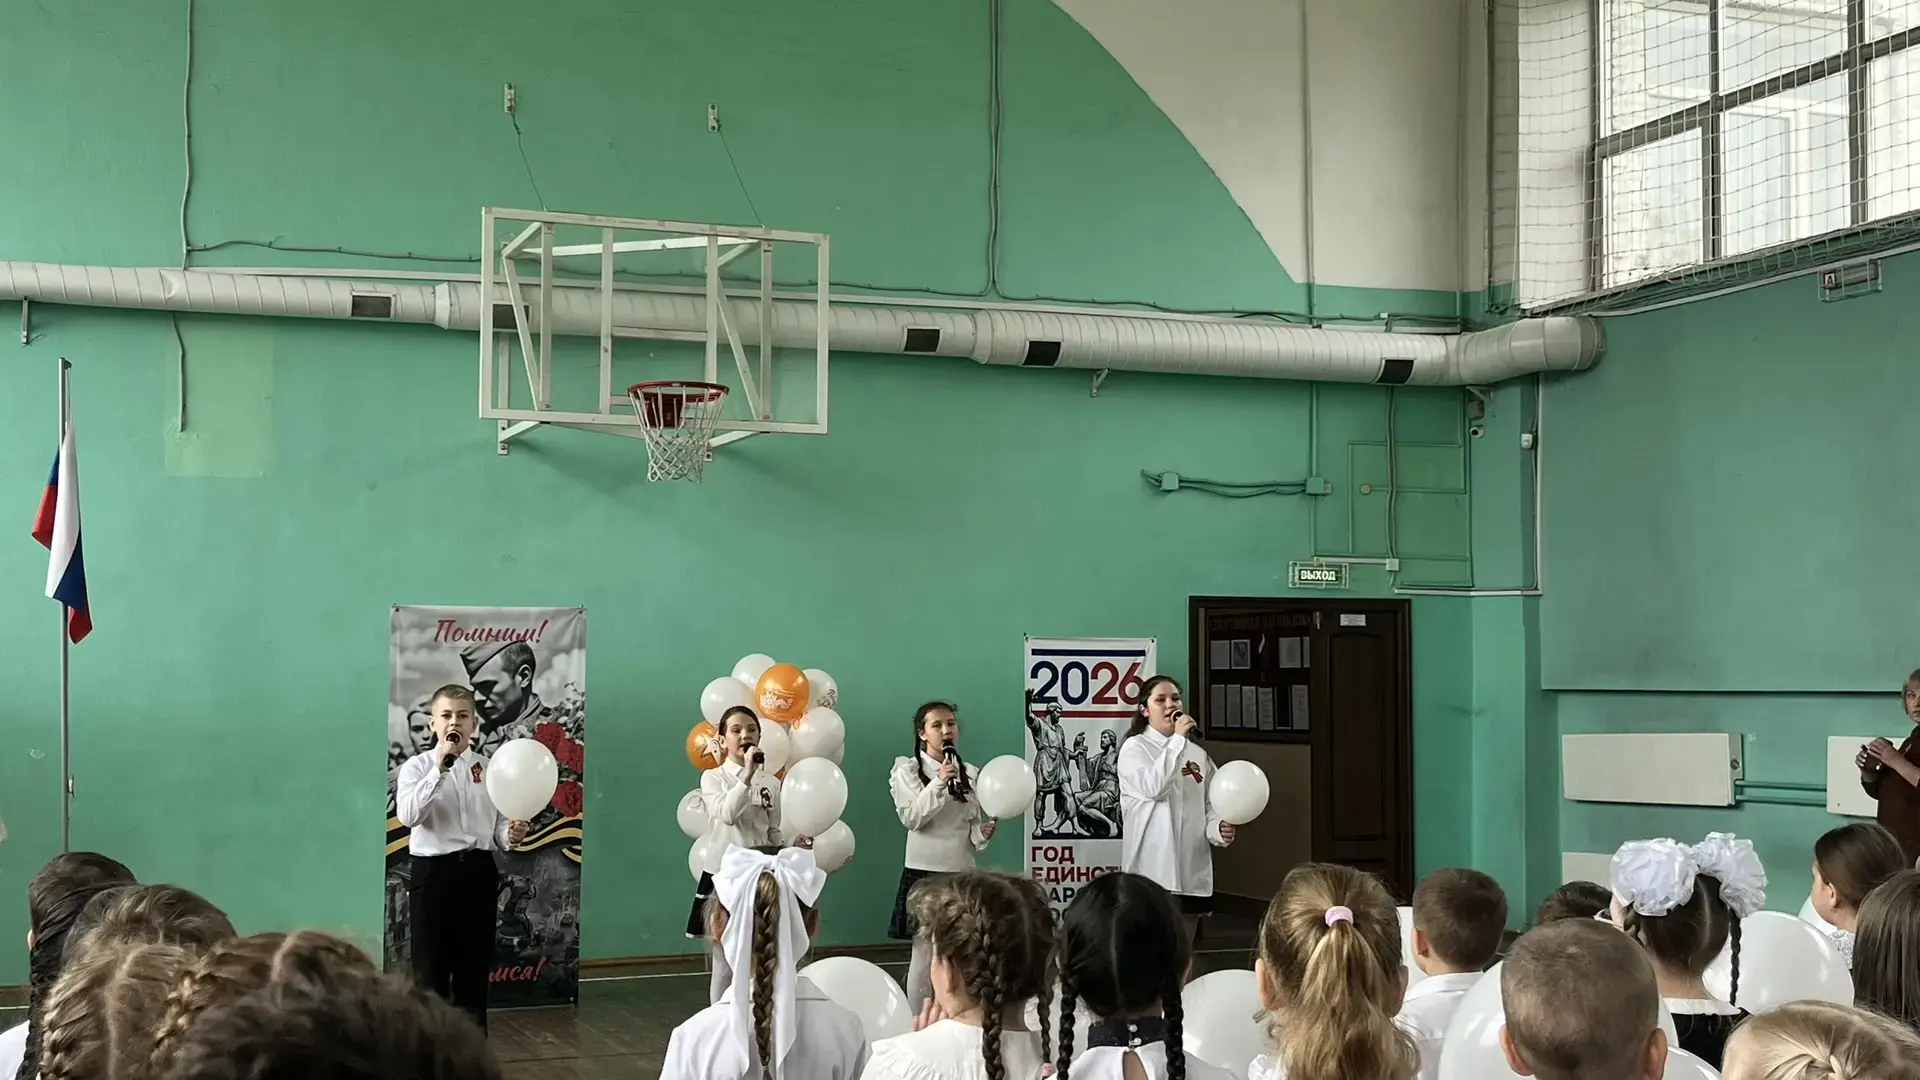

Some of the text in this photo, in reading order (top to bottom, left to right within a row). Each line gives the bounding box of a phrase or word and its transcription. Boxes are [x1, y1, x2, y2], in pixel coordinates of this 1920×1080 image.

[1300, 570, 1336, 581] ВЫХОД
[434, 619, 549, 644] Помним!
[1030, 660, 1145, 706] 2026
[1031, 846, 1075, 864] ГОД
[1031, 866, 1122, 885] ЕДИНС
